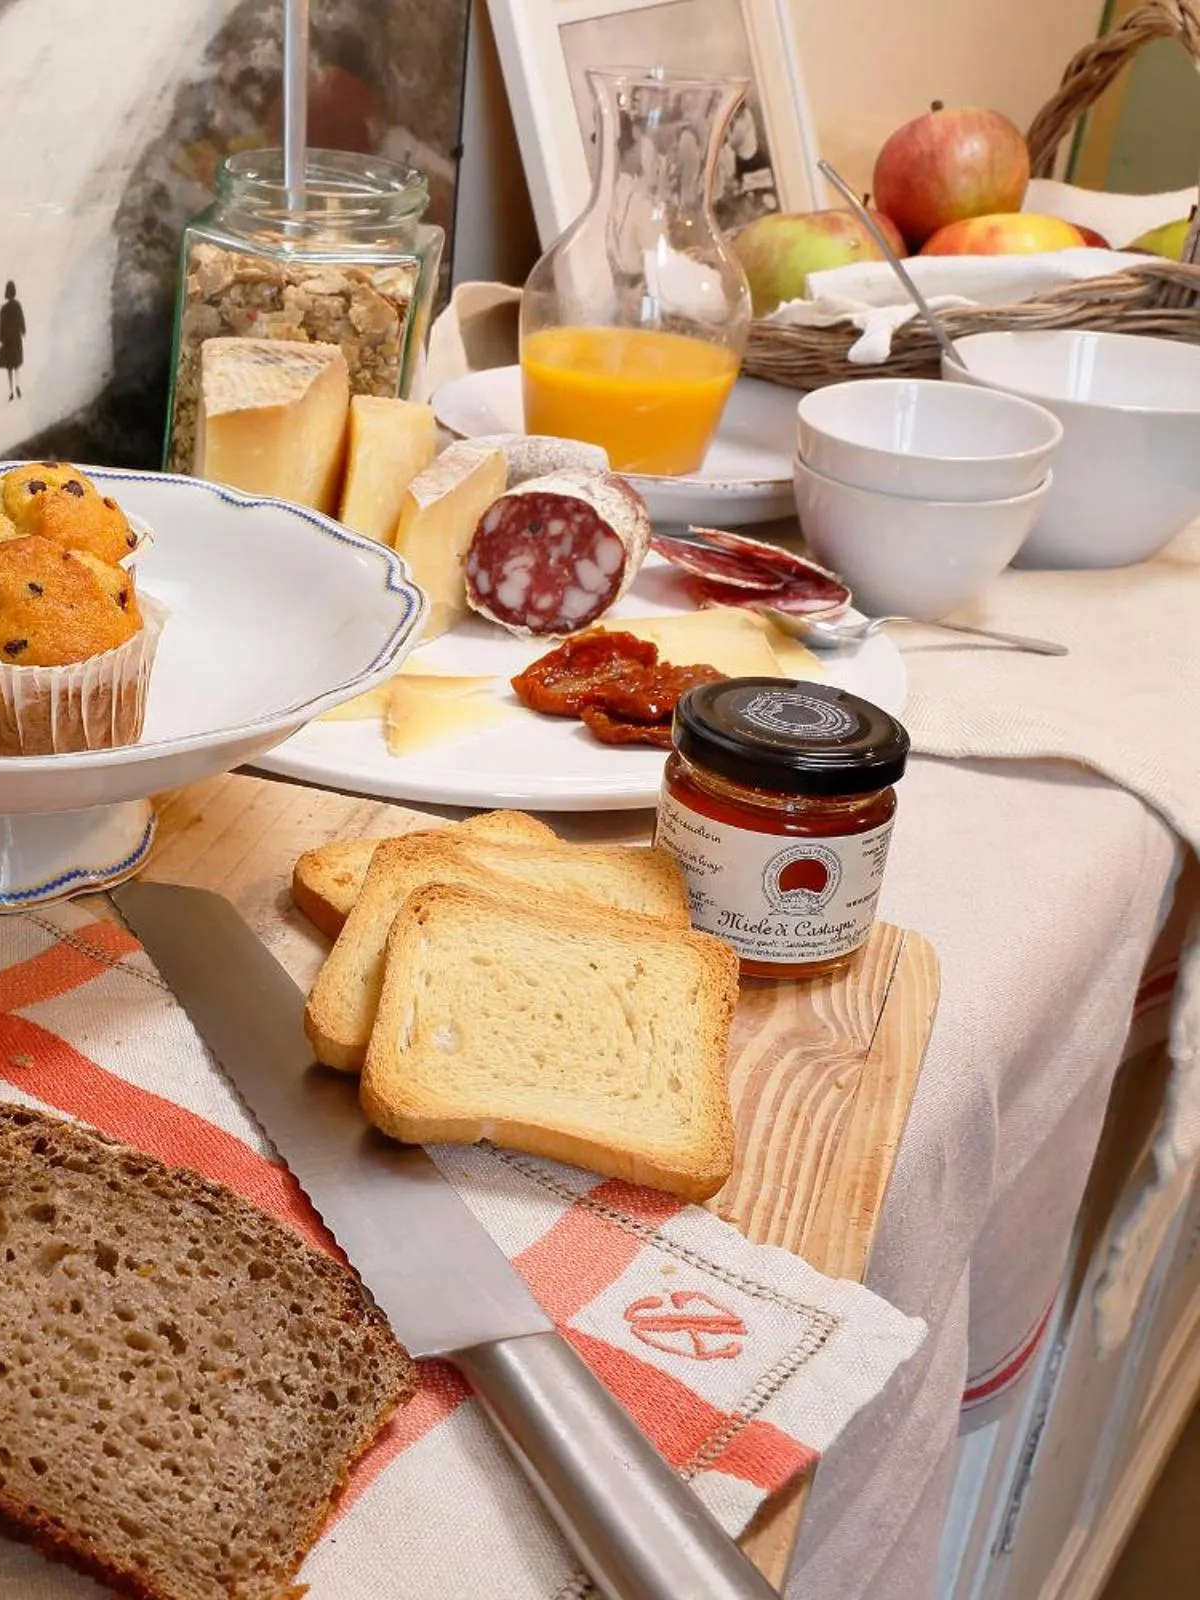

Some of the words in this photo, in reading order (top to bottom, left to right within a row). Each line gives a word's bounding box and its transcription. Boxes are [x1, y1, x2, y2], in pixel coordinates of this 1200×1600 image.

[717, 910, 773, 936] Miele
[774, 922, 789, 937] di
[794, 918, 857, 940] Castagno
